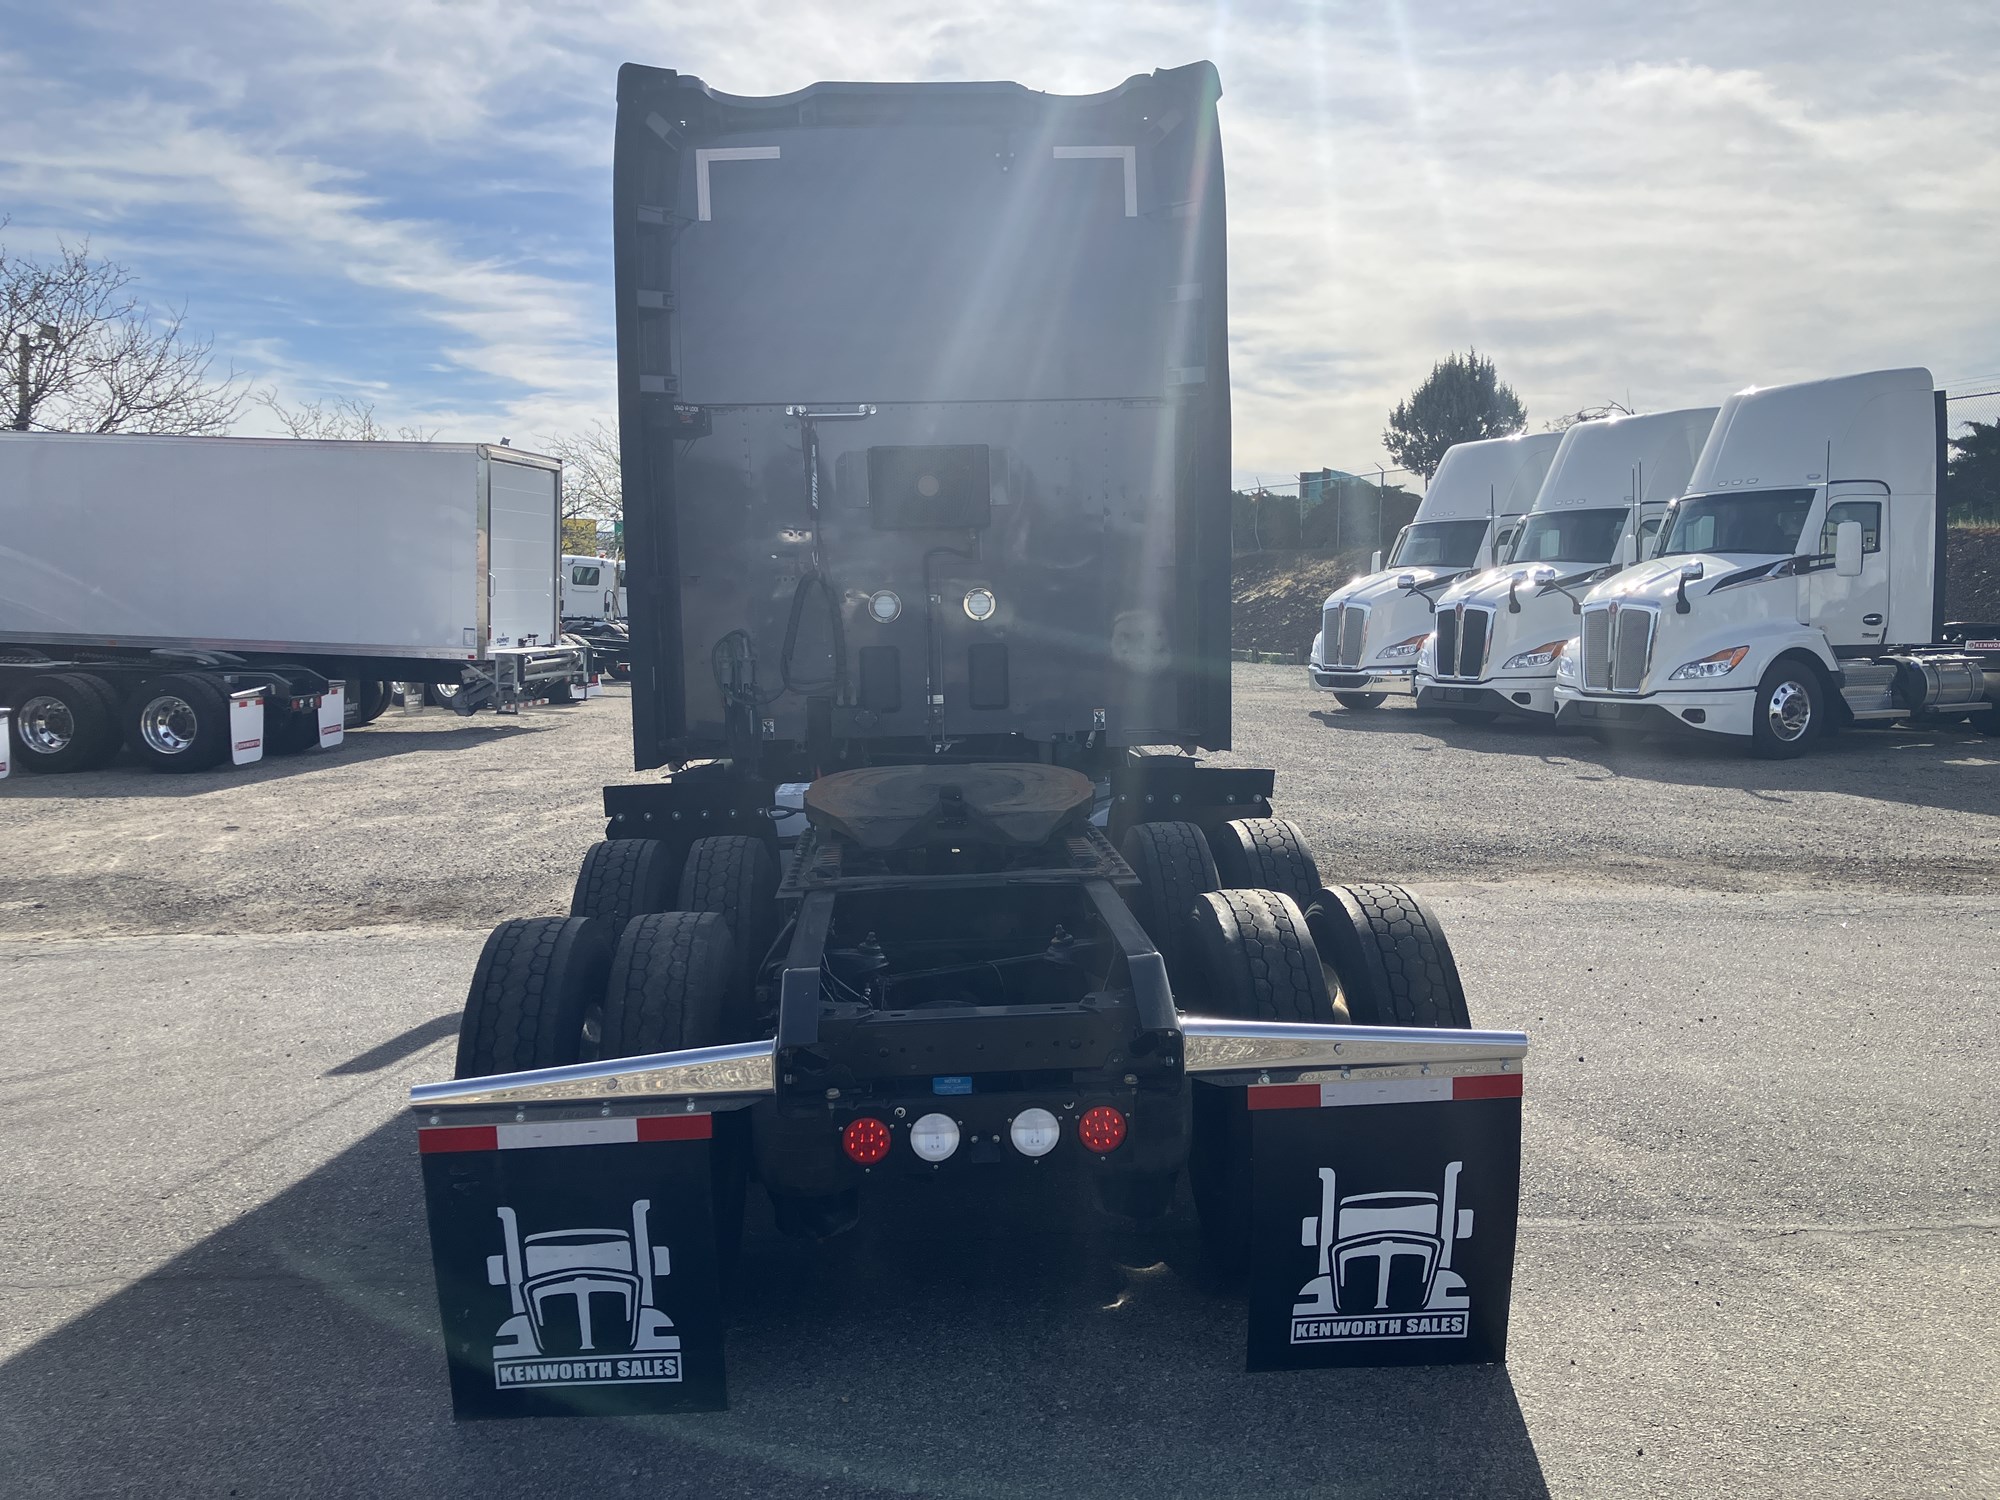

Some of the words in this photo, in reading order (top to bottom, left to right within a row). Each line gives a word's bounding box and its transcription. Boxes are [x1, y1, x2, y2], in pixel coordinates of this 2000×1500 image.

[1295, 1319, 1402, 1338] KENWORTH
[1406, 1317, 1463, 1333] SALES
[500, 1361, 612, 1383] KENWORTH
[617, 1359, 677, 1377] SALES
